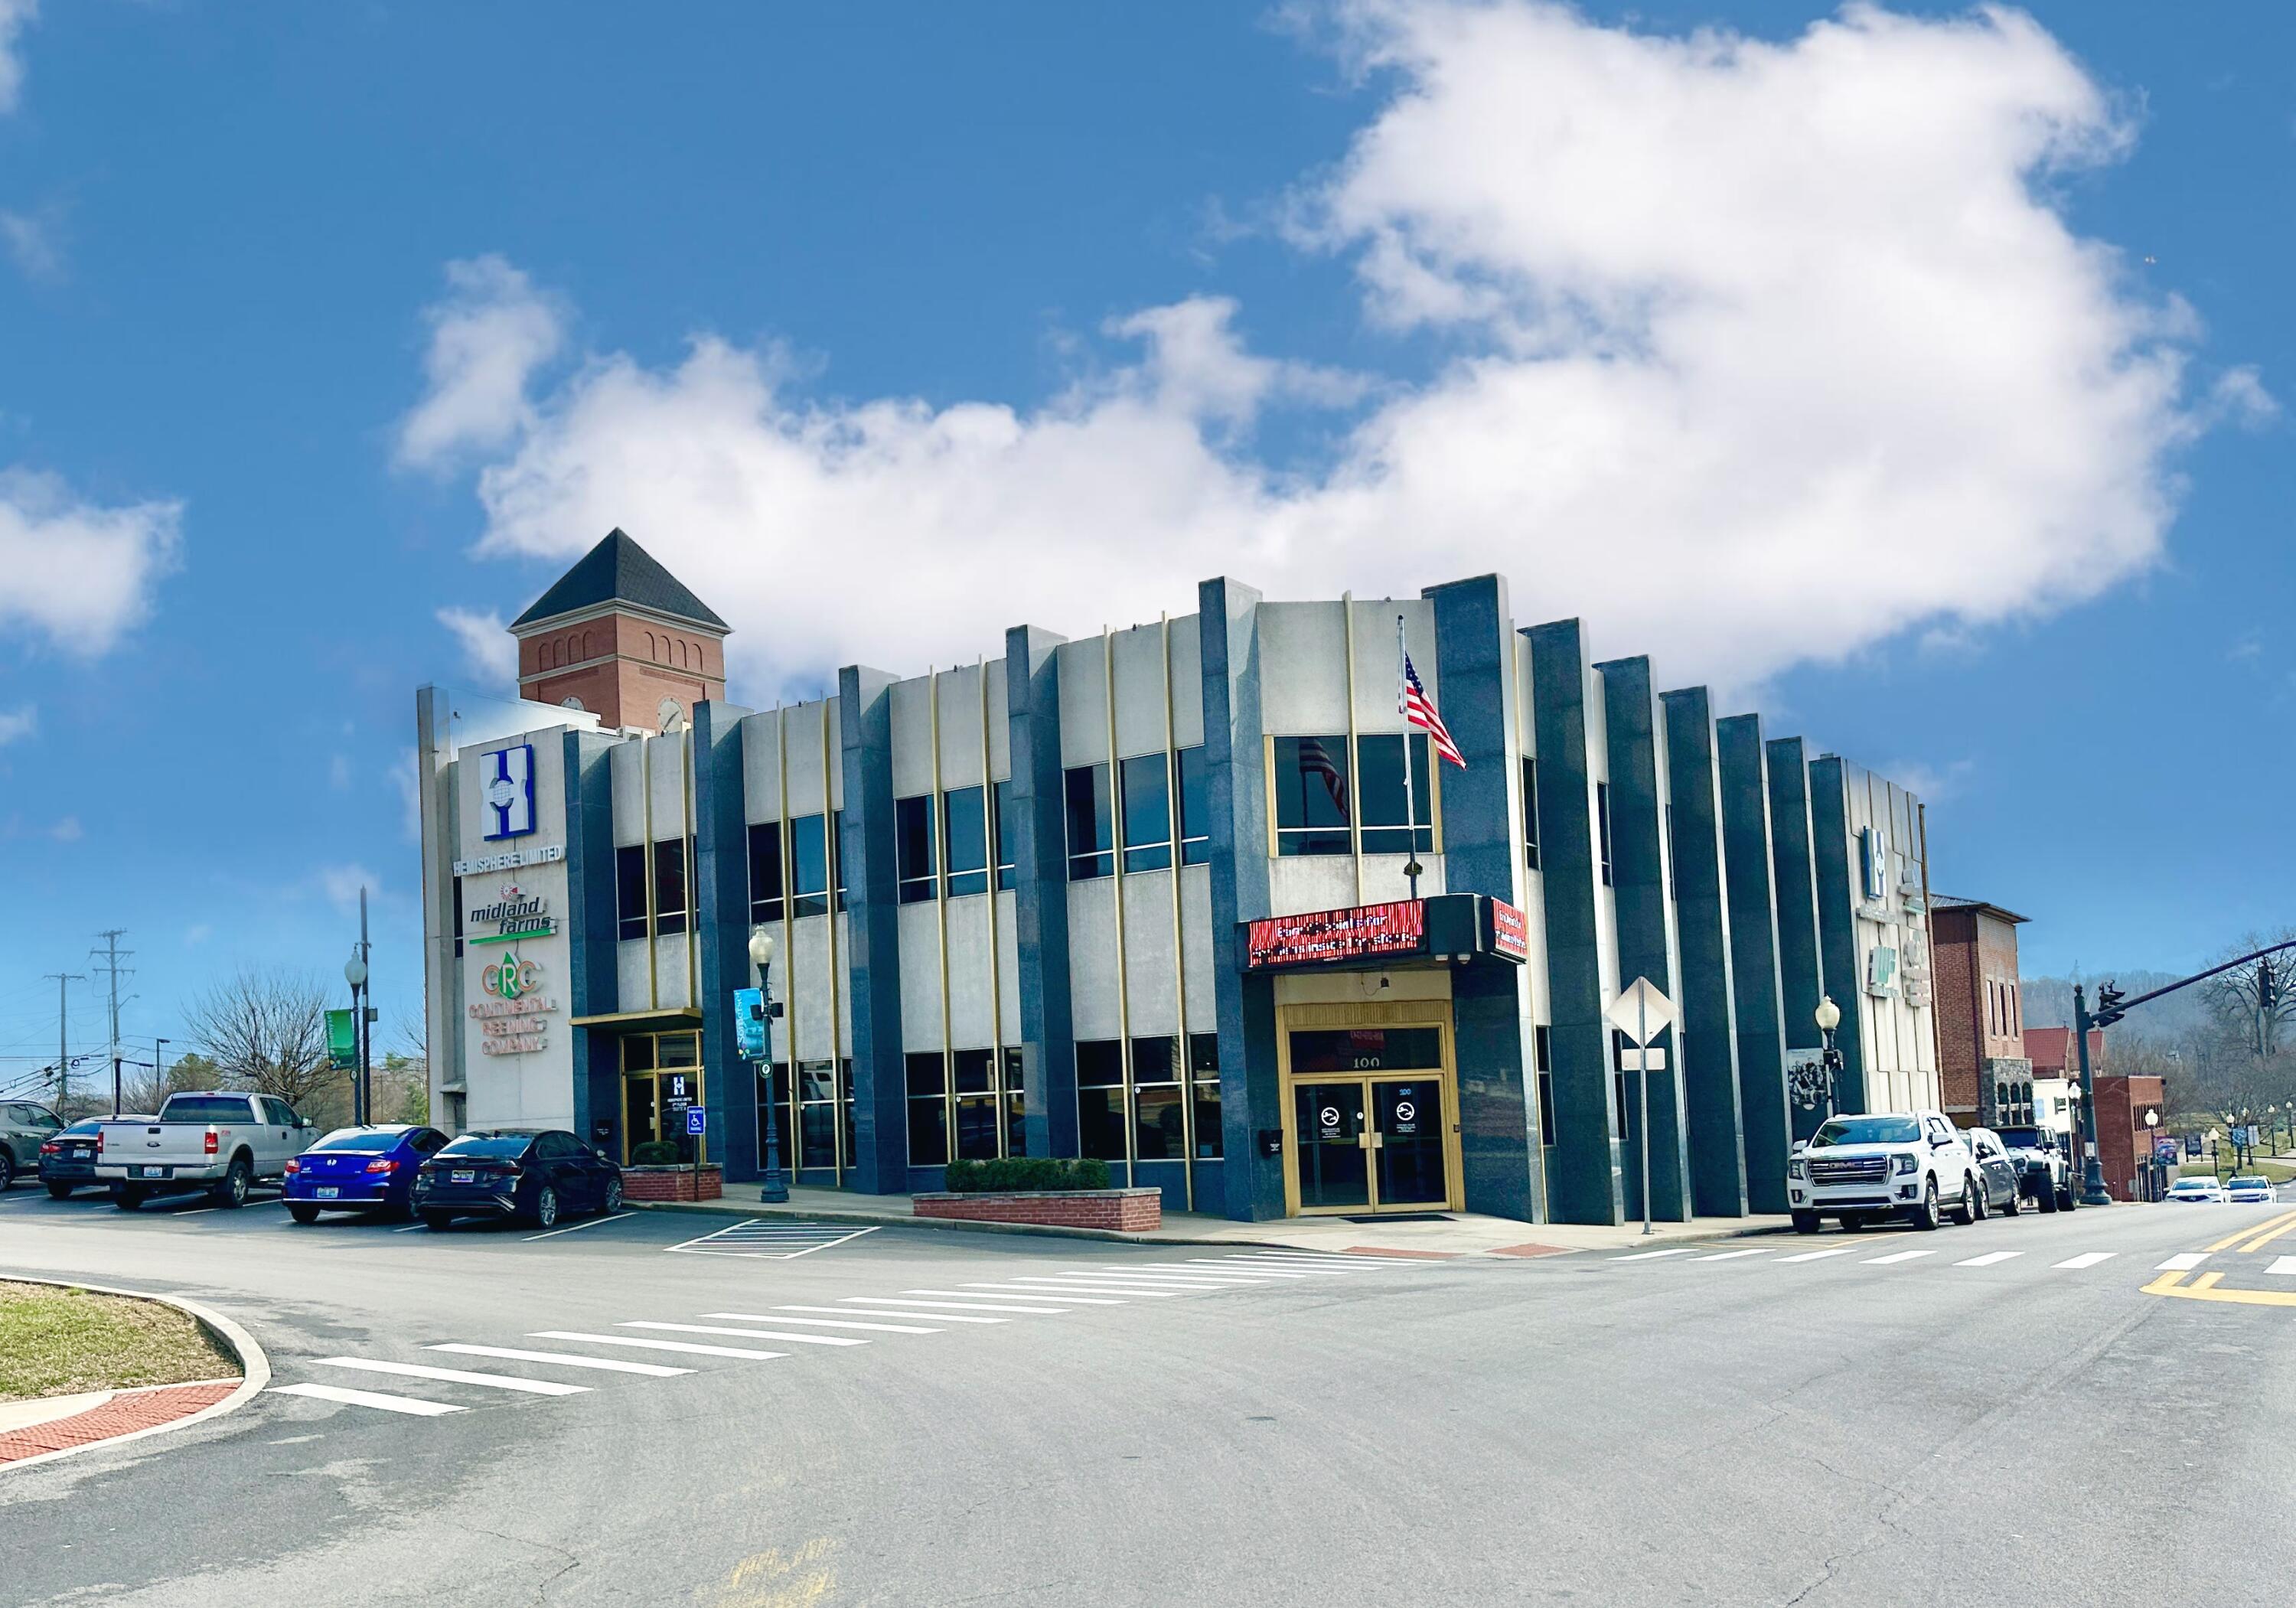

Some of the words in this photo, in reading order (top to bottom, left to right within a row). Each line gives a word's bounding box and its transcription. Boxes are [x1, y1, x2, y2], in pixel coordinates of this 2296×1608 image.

[453, 851, 520, 877] HEMISPHERE
[520, 845, 562, 866] LIMITED
[471, 896, 540, 922] midland
[499, 916, 551, 934] farms
[482, 961, 537, 995] CRC
[482, 1037, 540, 1055] COMPANY
[1353, 1057, 1380, 1068] 100
